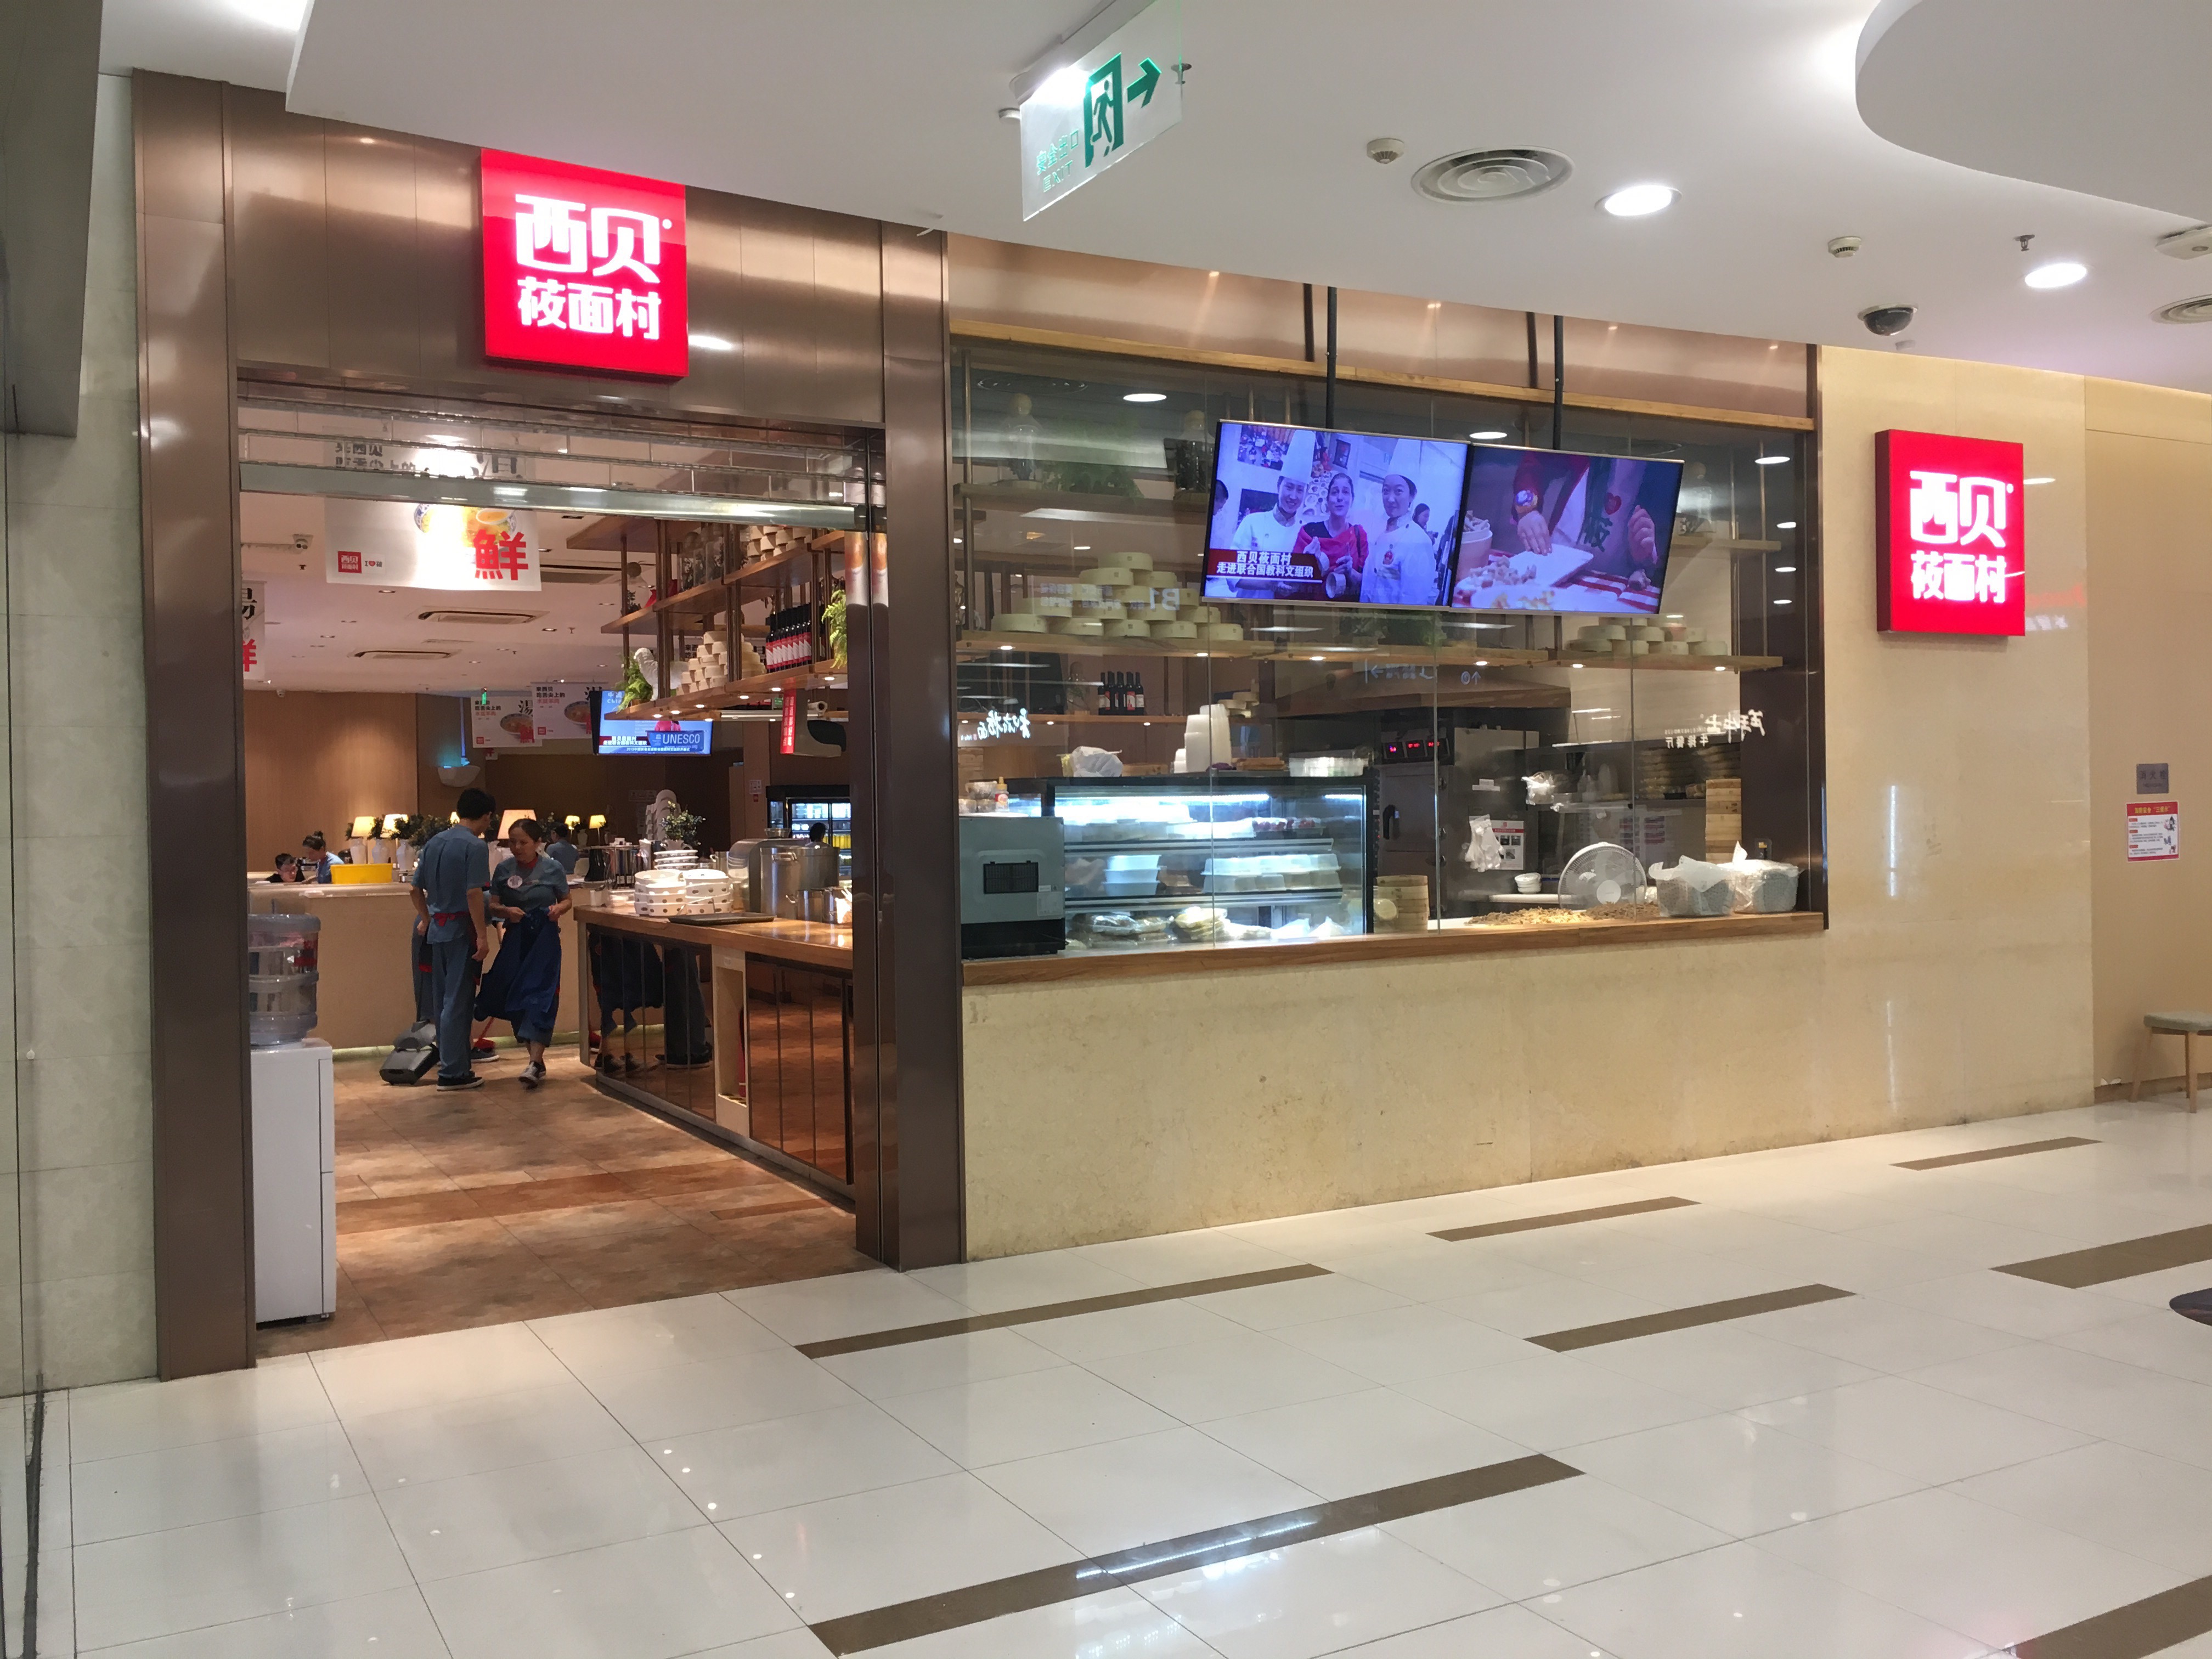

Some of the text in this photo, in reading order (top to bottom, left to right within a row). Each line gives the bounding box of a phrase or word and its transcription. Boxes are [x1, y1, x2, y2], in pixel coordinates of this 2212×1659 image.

[1036, 128, 1079, 176] 安全出口
[1043, 160, 1073, 193] EXIT
[515, 194, 661, 283] 西贝
[517, 276, 661, 340] 莜面村
[1910, 470, 2006, 548] 西贝
[1216, 562, 1314, 578] 走进联合国教科文组织
[1237, 550, 1292, 566] 西贝莜面村
[1911, 550, 2006, 603] 莜面村
[663, 733, 700, 744] UNESCO
